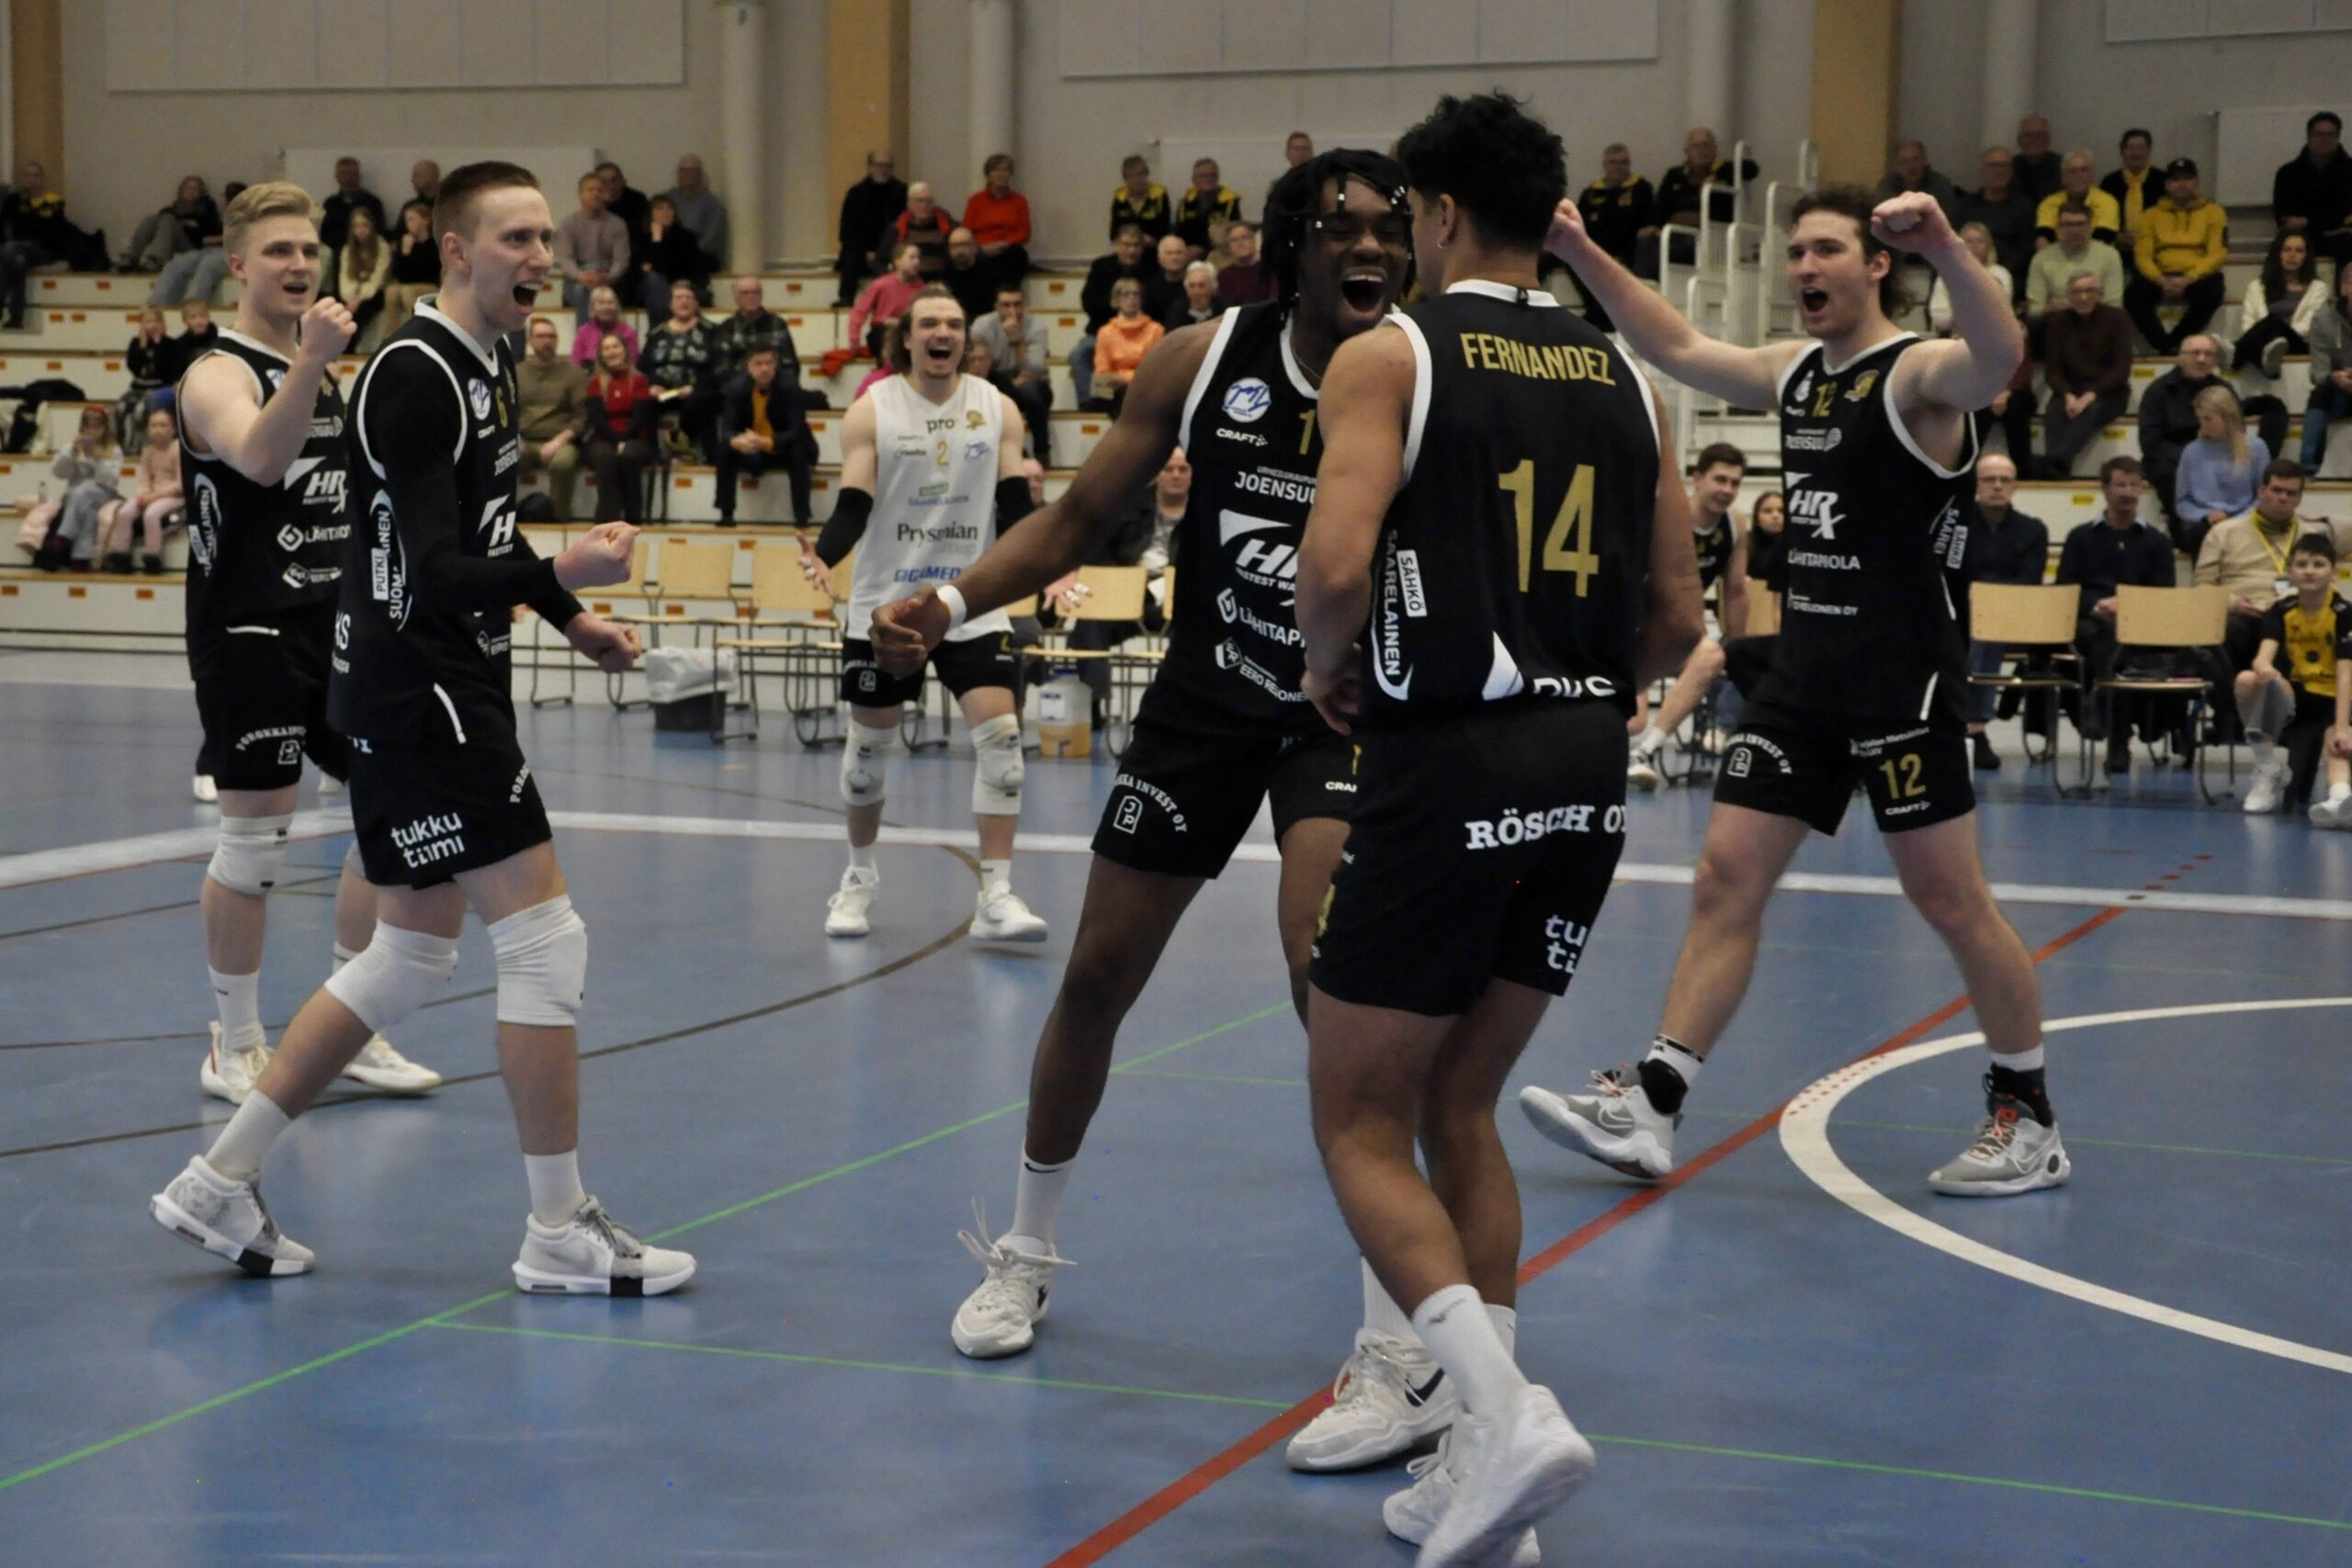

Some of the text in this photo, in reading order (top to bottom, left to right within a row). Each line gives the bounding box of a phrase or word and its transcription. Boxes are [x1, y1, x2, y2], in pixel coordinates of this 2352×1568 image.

[1459, 333, 1617, 386] FERNANDEZ
[926, 419, 955, 434] pro
[1216, 428, 1258, 444] CRAFT
[937, 441, 949, 466] 2
[898, 521, 978, 548] Prysmian
[1498, 459, 1599, 597] 14
[374, 556, 387, 592] PUTKI
[1400, 557, 1421, 613] SÄHKÖ
[1384, 528, 1401, 677] SAARELAINEN
[1240, 663, 1265, 685] EERO
[1879, 753, 1927, 799] 12
[1136, 779, 1178, 813] INVEST
[1172, 814, 1187, 832] OY
[391, 812, 463, 849] tukku
[1464, 804, 1595, 850] RÖSCH
[1545, 914, 1588, 947] tu
